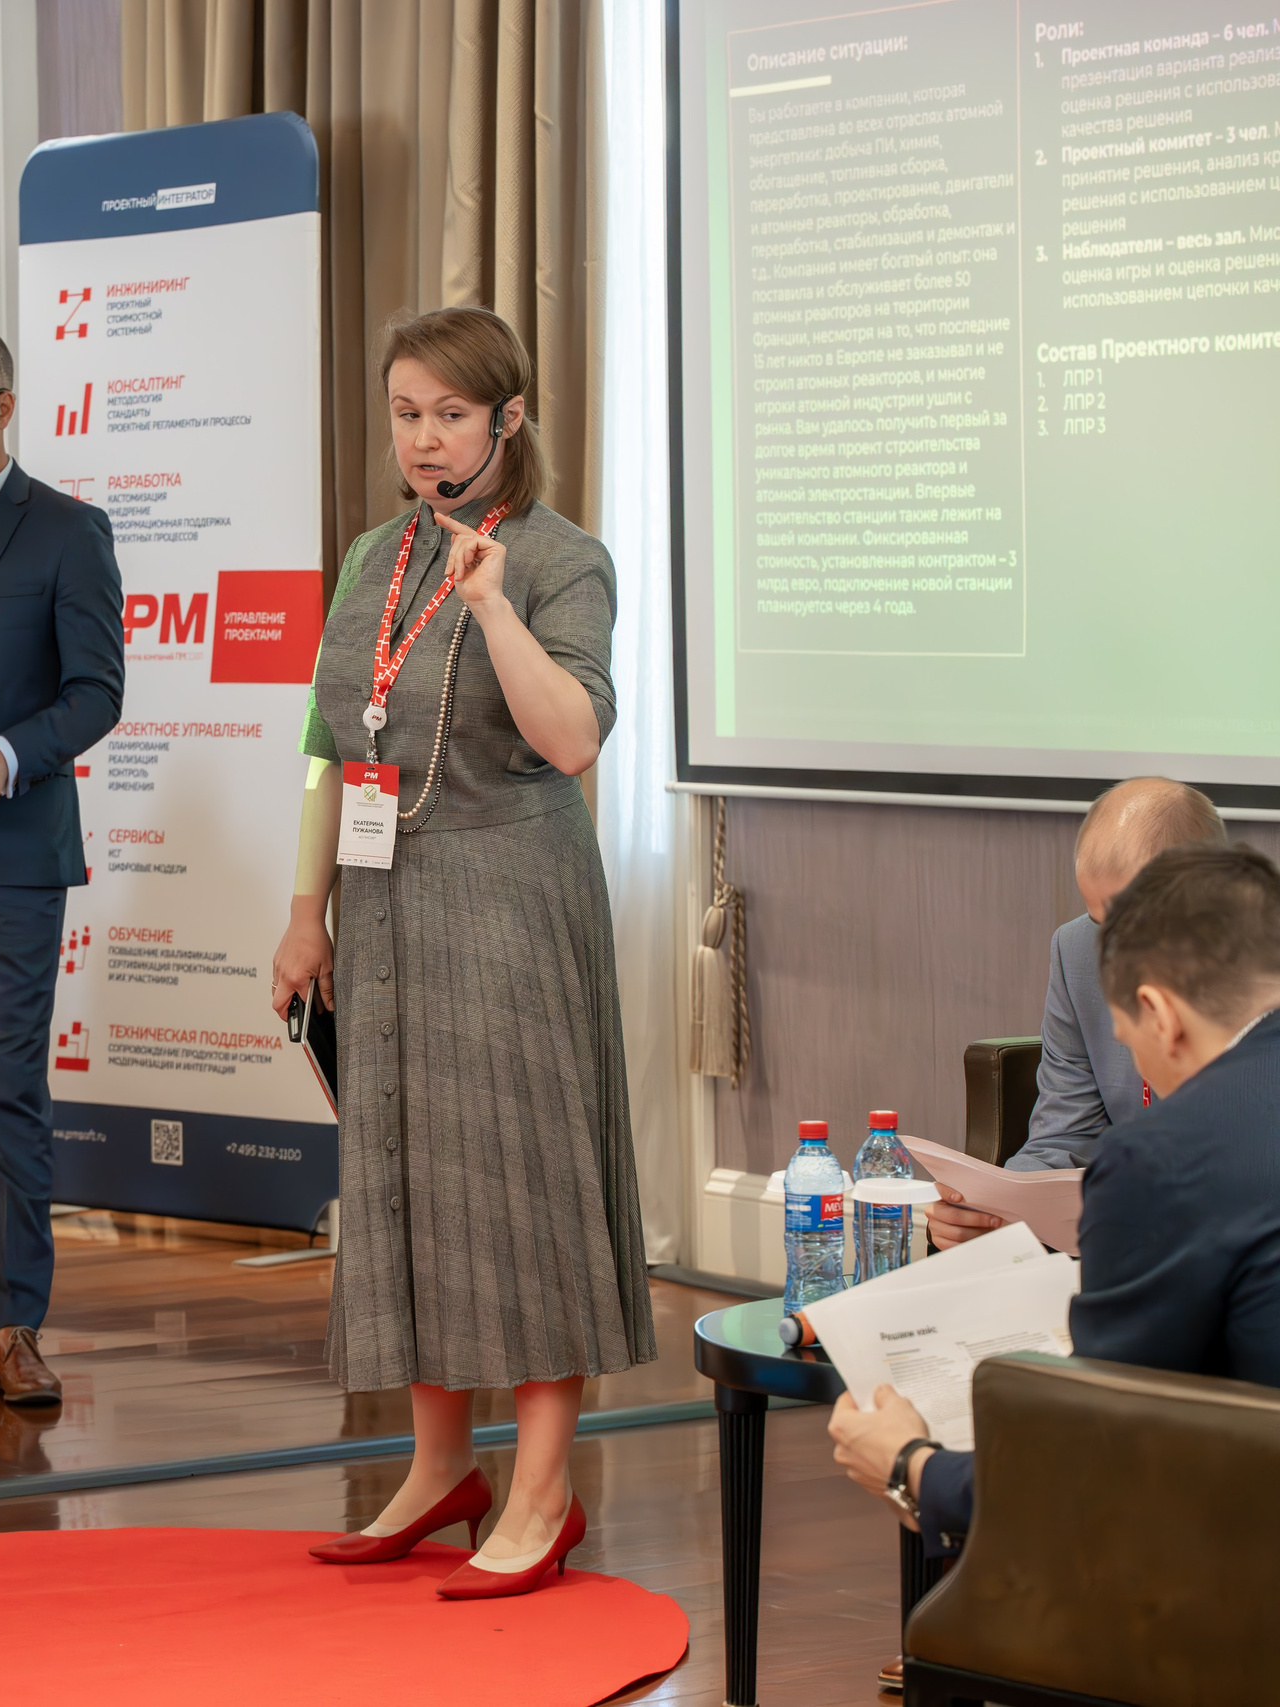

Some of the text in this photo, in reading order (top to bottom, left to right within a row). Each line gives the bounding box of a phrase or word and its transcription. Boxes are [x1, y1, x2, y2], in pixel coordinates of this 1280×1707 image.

[1035, 22, 1084, 43] Роли:
[748, 35, 908, 71] Описание ситуации:
[1034, 52, 1044, 68] 1.
[1061, 41, 1140, 66] Проектная
[1144, 32, 1209, 53] команда
[1224, 24, 1233, 41] 6
[1237, 23, 1269, 38] чел.
[1061, 64, 1152, 92] презентация
[1157, 55, 1224, 79] варианта
[1061, 95, 1111, 114] оценка
[1115, 86, 1180, 110] решения
[1185, 85, 1192, 98] с
[1061, 109, 1192, 138] качества решения
[1035, 149, 1047, 166] 2.
[1062, 137, 1144, 165] Проектный
[1149, 132, 1212, 153] комитет
[1226, 126, 1235, 143] 3
[1239, 125, 1270, 141] чел.
[1062, 167, 1130, 190] принятие
[1134, 159, 1203, 183] решения,
[1207, 152, 1259, 171] анализ
[102, 189, 214, 212] ПРОЕКТНЫЙ ИНТЕГРАТОР
[1062, 177, 1266, 216] решения с использованием
[1062, 217, 1126, 240] решения
[1036, 245, 1048, 262] 3.
[1063, 237, 1163, 260] Наблюдатели
[1177, 232, 1212, 249] весь
[1215, 230, 1246, 246] зал.
[1063, 267, 1112, 285] оценка
[1116, 264, 1151, 282] игры
[1156, 263, 1165, 276] и
[1169, 257, 1221, 276] оценка
[106, 277, 190, 298] ИНЖИНИРИНГ
[1063, 286, 1183, 309] использованием
[1187, 280, 1250, 301] цепочки
[1037, 343, 1097, 363] Состав
[1102, 336, 1210, 364] Проектного
[107, 375, 185, 394] КОНСАЛТИНГ
[1037, 368, 1102, 388] 1. ЛПР 1
[1037, 392, 1106, 412] 2. ЛПР 2
[1037, 417, 1106, 436] 3. ЛПР 3
[108, 472, 182, 490] РАЗРАБОТКА
[112, 519, 182, 530] НФОРМАЦИОННАЯ
[756, 507, 1002, 527] строительство станции также лежит на
[757, 530, 968, 547] вашей компании. Фиксированная
[757, 555, 819, 571] стоимость,
[822, 555, 915, 572] установленная
[919, 553, 996, 571] контрактом
[1009, 550, 1017, 566] 3
[758, 575, 1012, 593] млрд евро, подключение новой станции
[224, 612, 286, 624] УПРАВЛЕНИЕ
[757, 599, 916, 617] планируется через 4 года.
[224, 629, 281, 641] ПРОЕКТАМИ
[181, 723, 262, 738] УПРАВЛЕНИЕ
[108, 755, 158, 764] РЕАЛИЗАЦИЯ
[108, 768, 148, 778] КОНТРОЛЬ
[108, 829, 165, 844] СЕРВИСЫ
[108, 926, 173, 944] ОБУЧЕНИЕ
[109, 1024, 282, 1050] ТЕХНИЧЕСКАЯ ПОДДЕРЖКА
